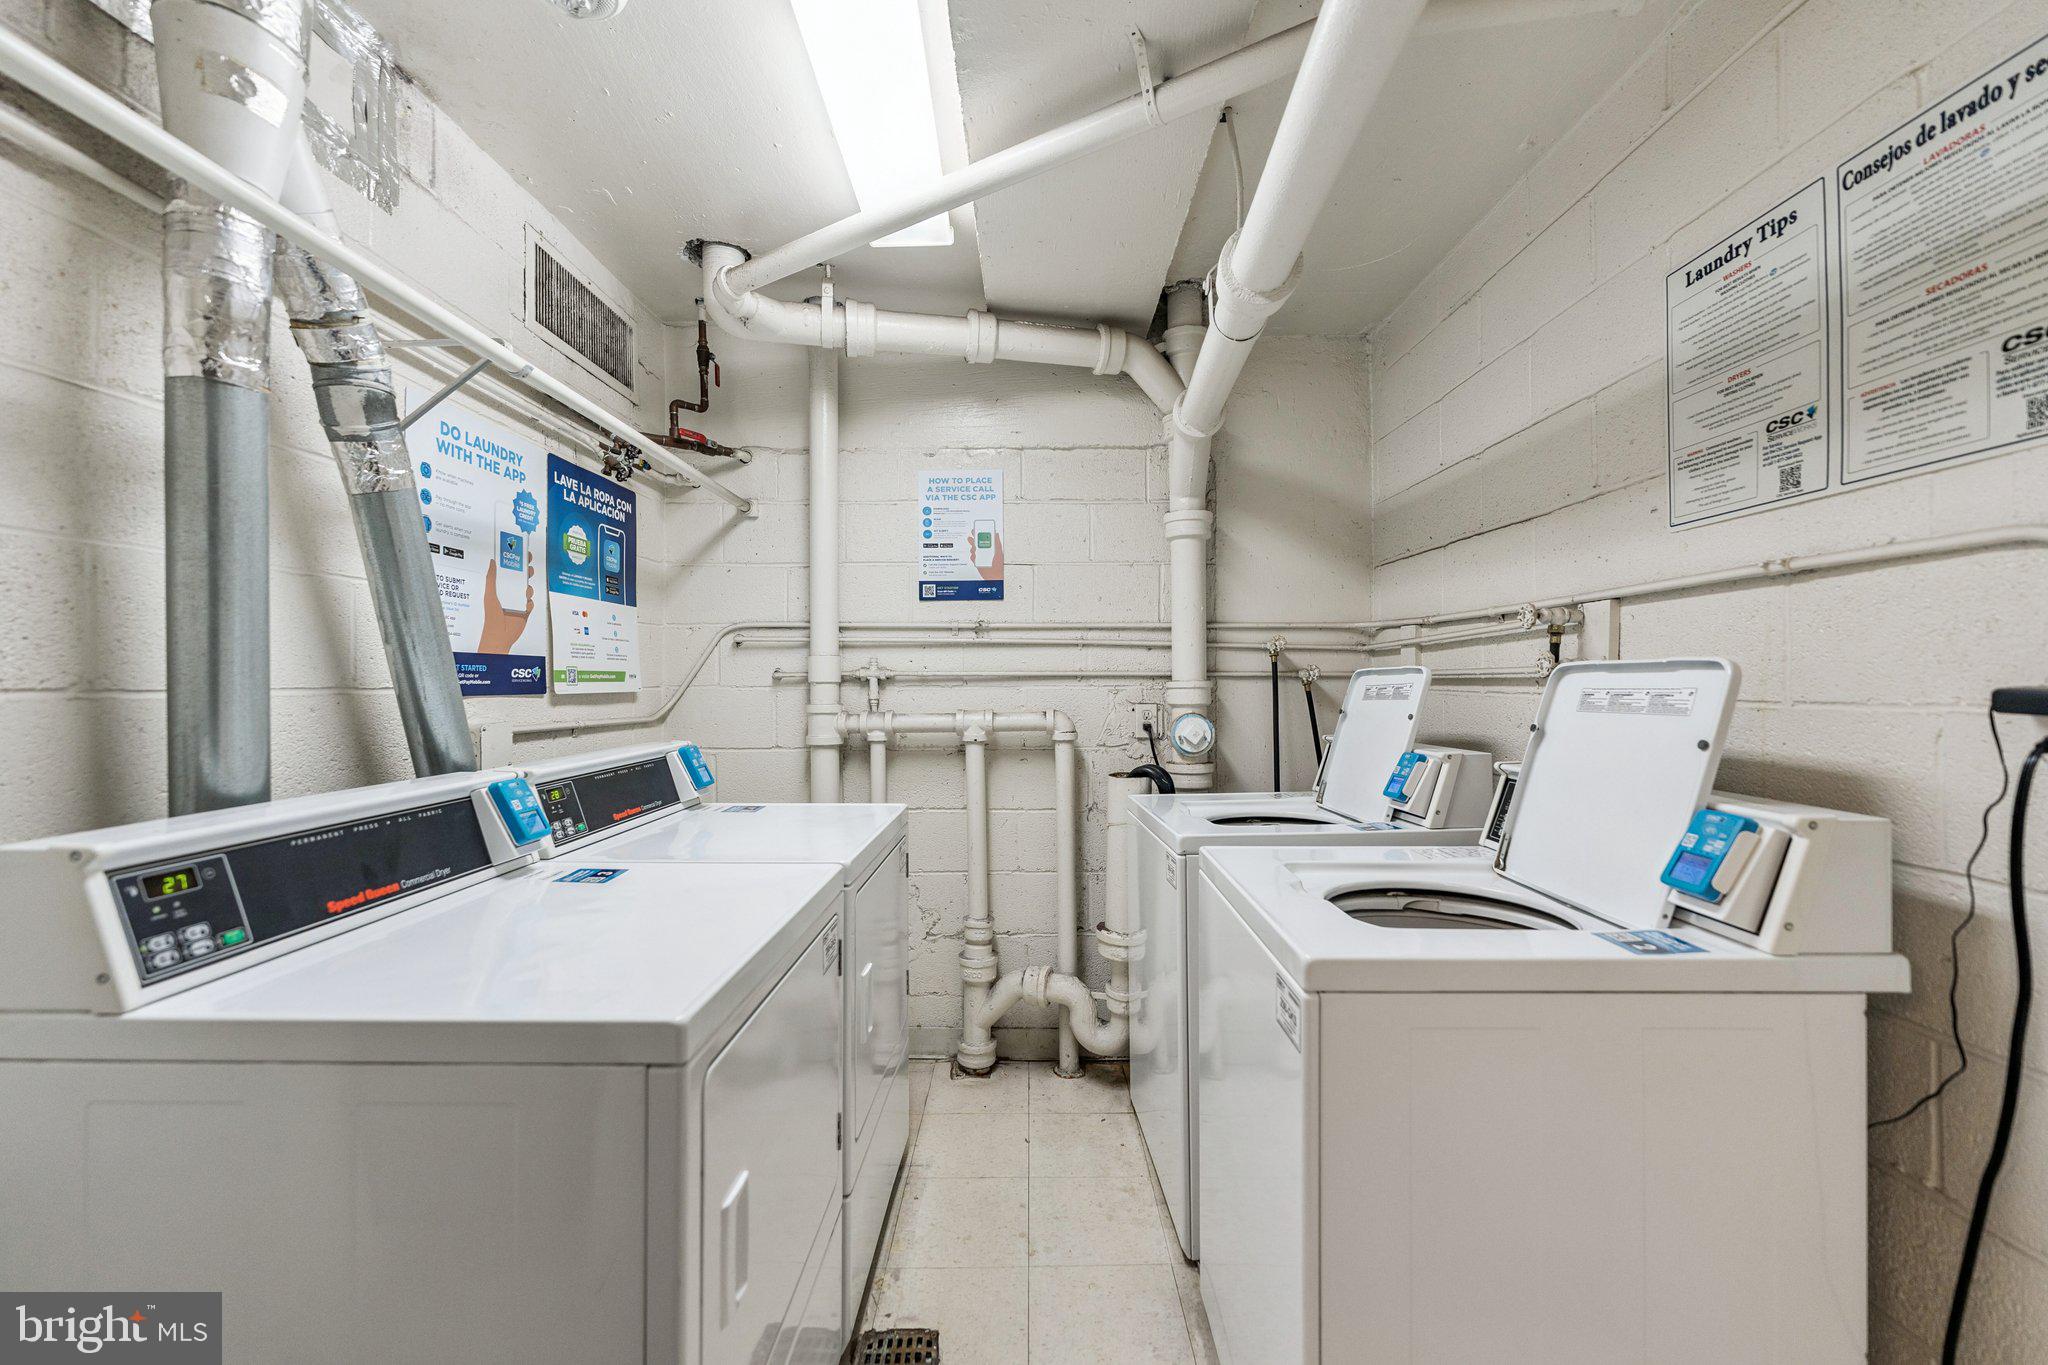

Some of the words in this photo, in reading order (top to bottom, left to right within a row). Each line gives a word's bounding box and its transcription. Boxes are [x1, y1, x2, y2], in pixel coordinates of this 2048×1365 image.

[1842, 139, 1912, 190] Consejos
[1916, 124, 1936, 147] de
[1940, 84, 2003, 134] lavado
[2007, 72, 2021, 100] y
[2025, 56, 2048, 82] se
[1923, 123, 1986, 166] LAVADORAS
[1685, 237, 1753, 288] Laundry
[1756, 208, 1798, 244] Tips
[1722, 261, 1752, 282] WASHERS
[1924, 262, 1988, 296] SECADORAS
[2002, 326, 2048, 352] CS
[1728, 368, 1752, 383] DRYERS
[1766, 410, 1804, 433] CSC
[440, 420, 460, 440] DO
[465, 432, 522, 466] LAUNDRY
[436, 437, 472, 464] WITH
[476, 454, 500, 475] THE
[504, 466, 526, 483] APP
[554, 470, 578, 492] LAVE
[580, 482, 592, 498] LA
[594, 488, 615, 507] ROPA
[617, 498, 632, 514] CON
[564, 488, 576, 504] LA
[578, 495, 625, 522] APLICACIÓN
[568, 536, 586, 548] PRUEBA
[570, 544, 586, 554] GRATIS
[446, 576, 466, 585] SUBMIT
[445, 591, 470, 600] REQUEST
[511, 668, 532, 678] CSC
[550, 790, 560, 800] 28
[613, 810, 628, 821] Speed
[627, 806, 641, 815] Queen
[290, 830, 344, 846] PERMANENT
[353, 822, 379, 832] PRESS
[418, 808, 442, 818] FABRIC
[162, 874, 188, 894] 27
[326, 890, 366, 914] Speed
[365, 882, 400, 900] Queen
[400, 872, 436, 890] Commercial
[435, 866, 451, 880] Dryer
